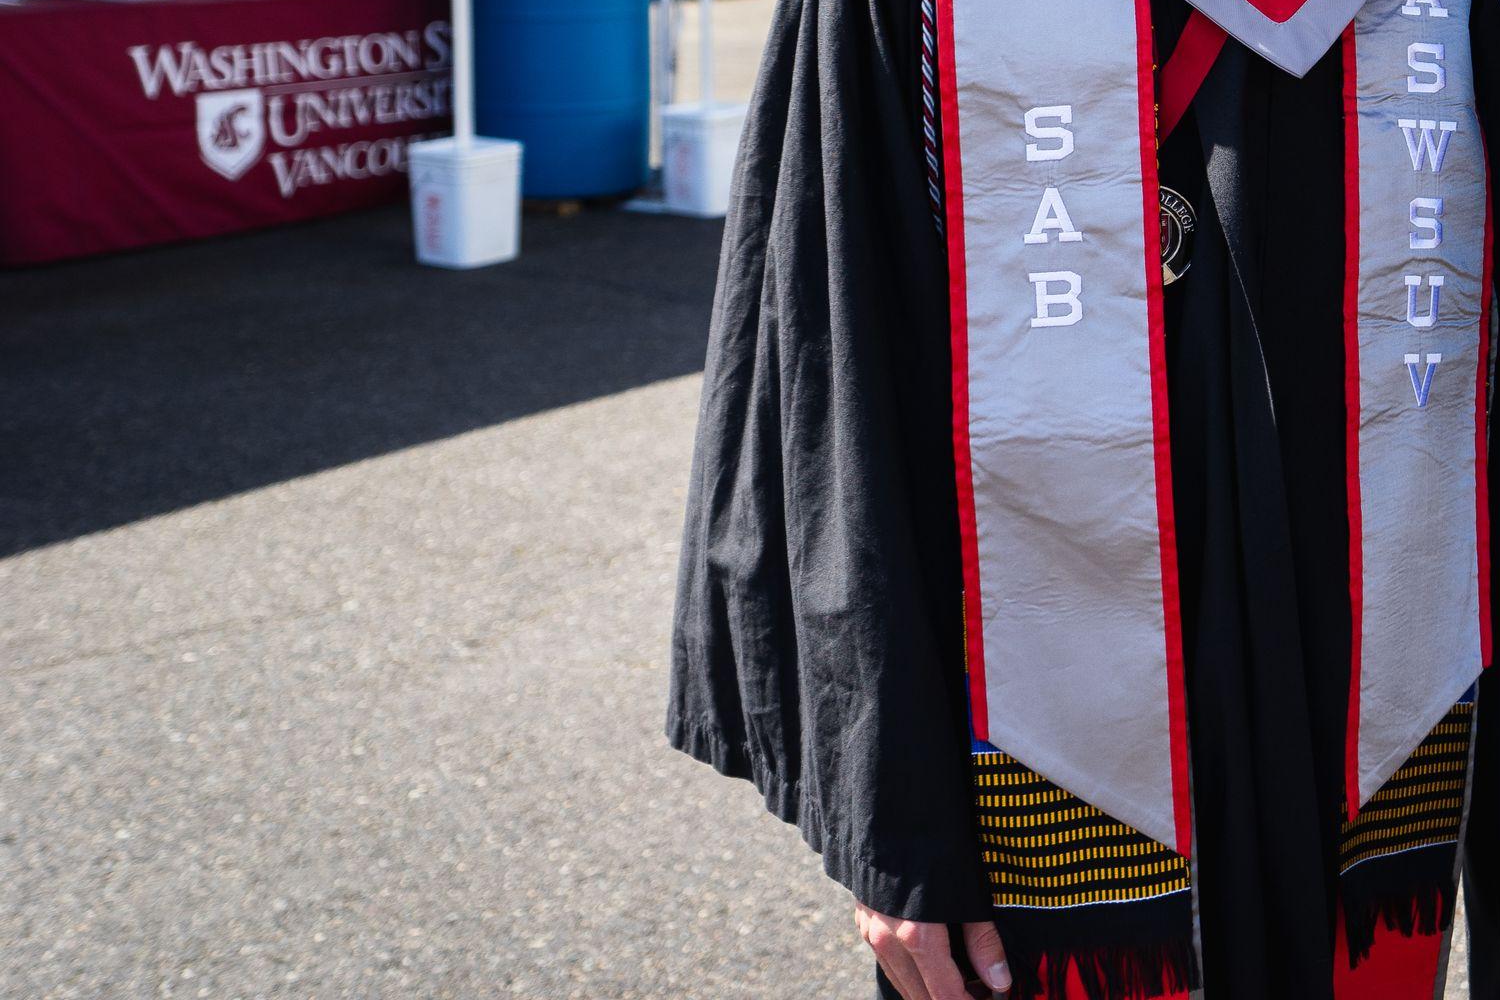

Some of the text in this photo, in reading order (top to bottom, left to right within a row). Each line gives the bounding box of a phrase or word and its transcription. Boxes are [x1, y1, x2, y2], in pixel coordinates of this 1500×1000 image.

[128, 30, 421, 100] WASHINGTON
[268, 80, 448, 147] UNIVERSI
[267, 131, 411, 198] VANCOU
[1024, 104, 1083, 328] SAB
